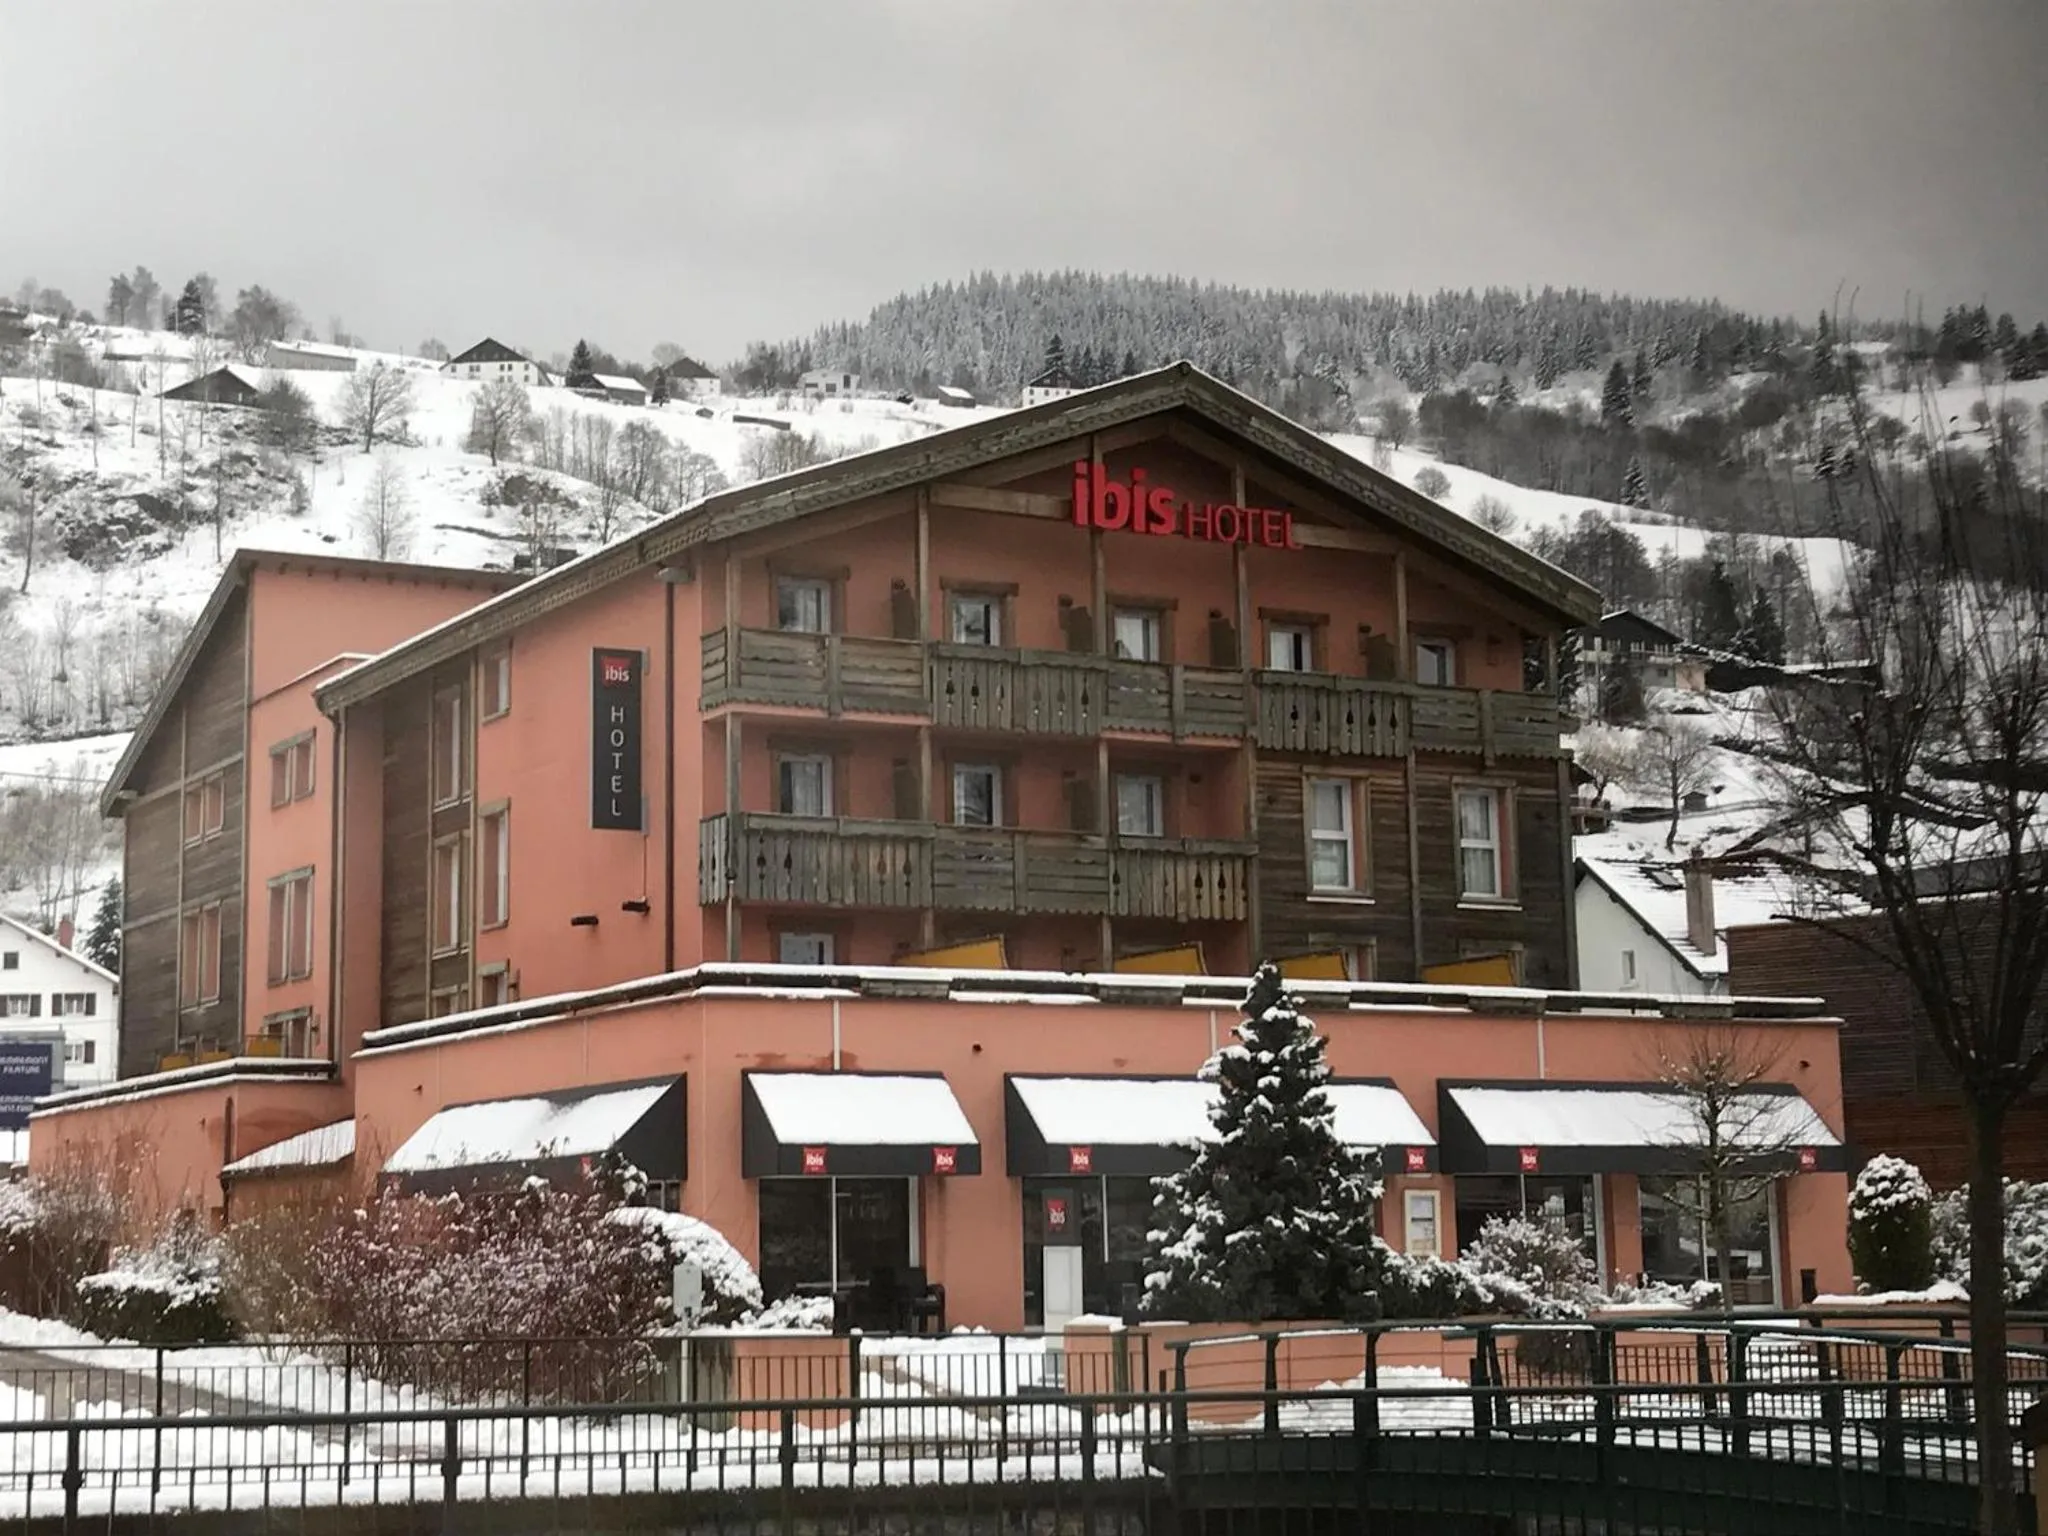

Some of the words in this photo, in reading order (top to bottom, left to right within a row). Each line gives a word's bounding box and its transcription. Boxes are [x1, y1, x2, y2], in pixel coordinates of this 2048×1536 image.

[1074, 458, 1177, 535] ibis
[1183, 501, 1304, 550] HOTEL
[605, 666, 631, 682] ibis
[611, 705, 625, 817] HOTEL
[806, 1153, 824, 1166] ibis
[936, 1153, 954, 1166] ibis
[1049, 1207, 1066, 1224] ibis
